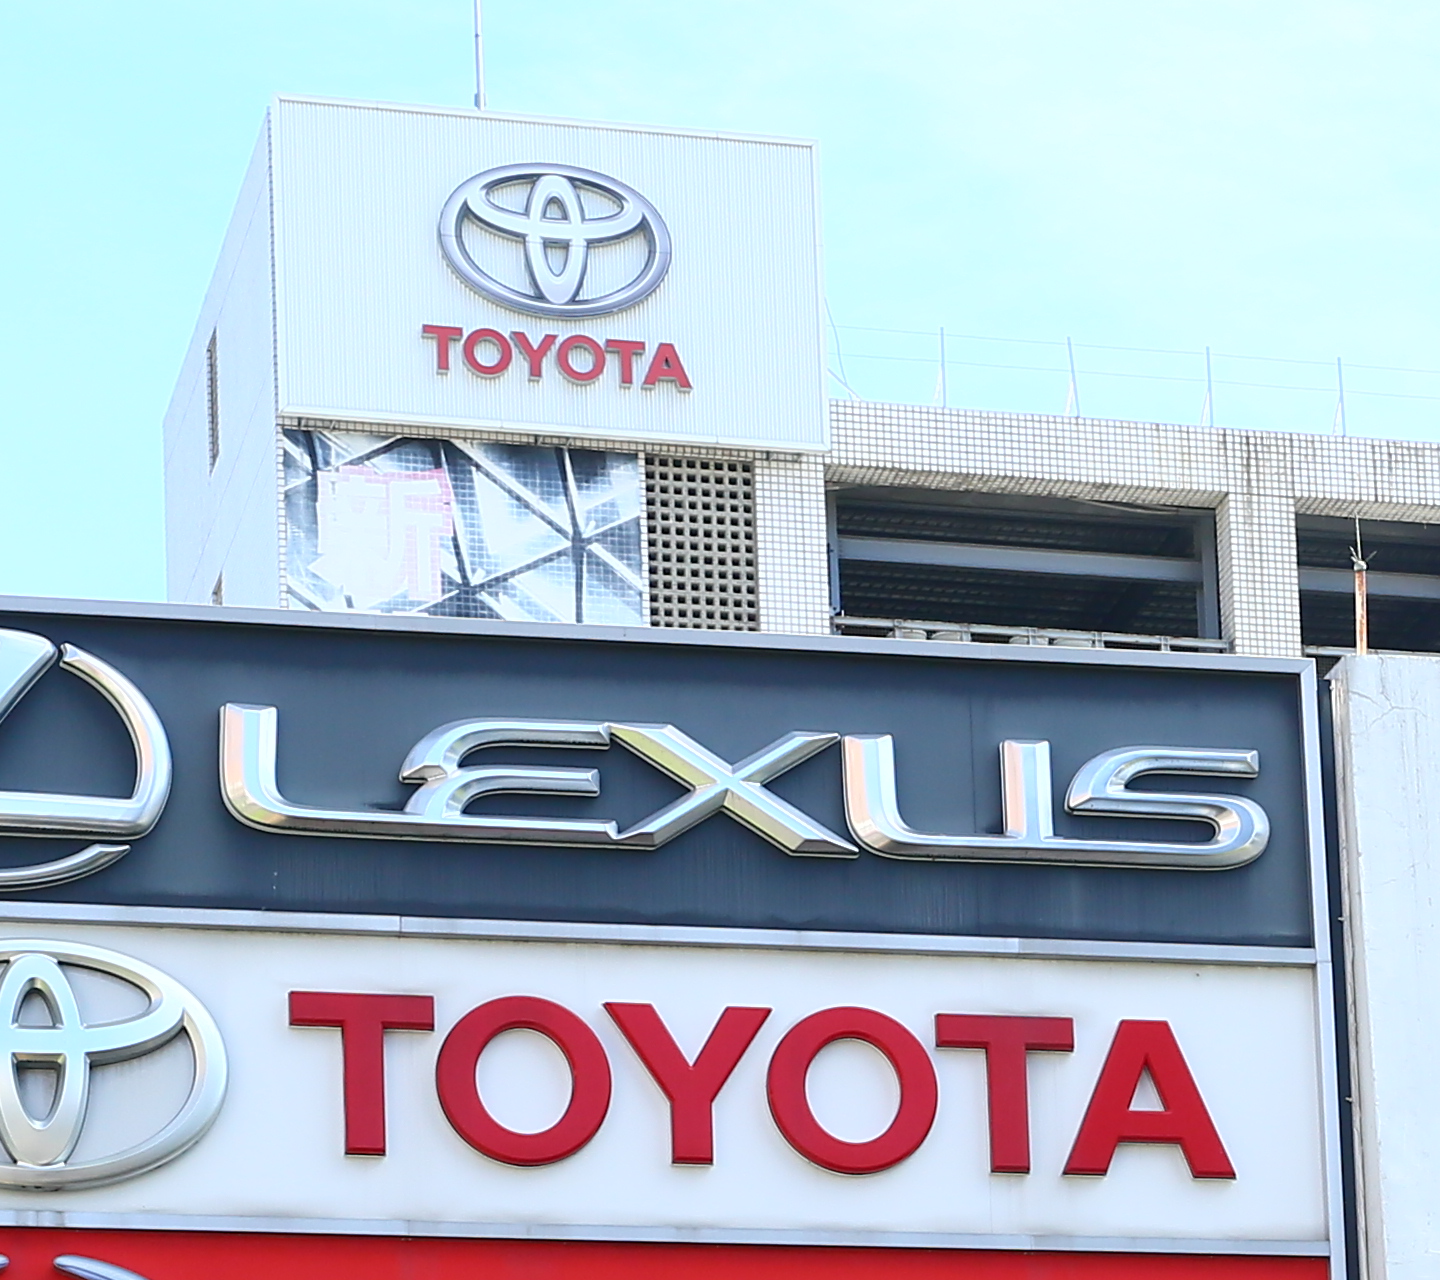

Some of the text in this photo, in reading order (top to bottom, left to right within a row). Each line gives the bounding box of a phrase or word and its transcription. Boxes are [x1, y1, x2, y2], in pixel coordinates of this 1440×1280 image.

[422, 323, 693, 393] TOYOTA
[220, 704, 1270, 869] LEXUS
[287, 989, 1236, 1181] TOYOTA
